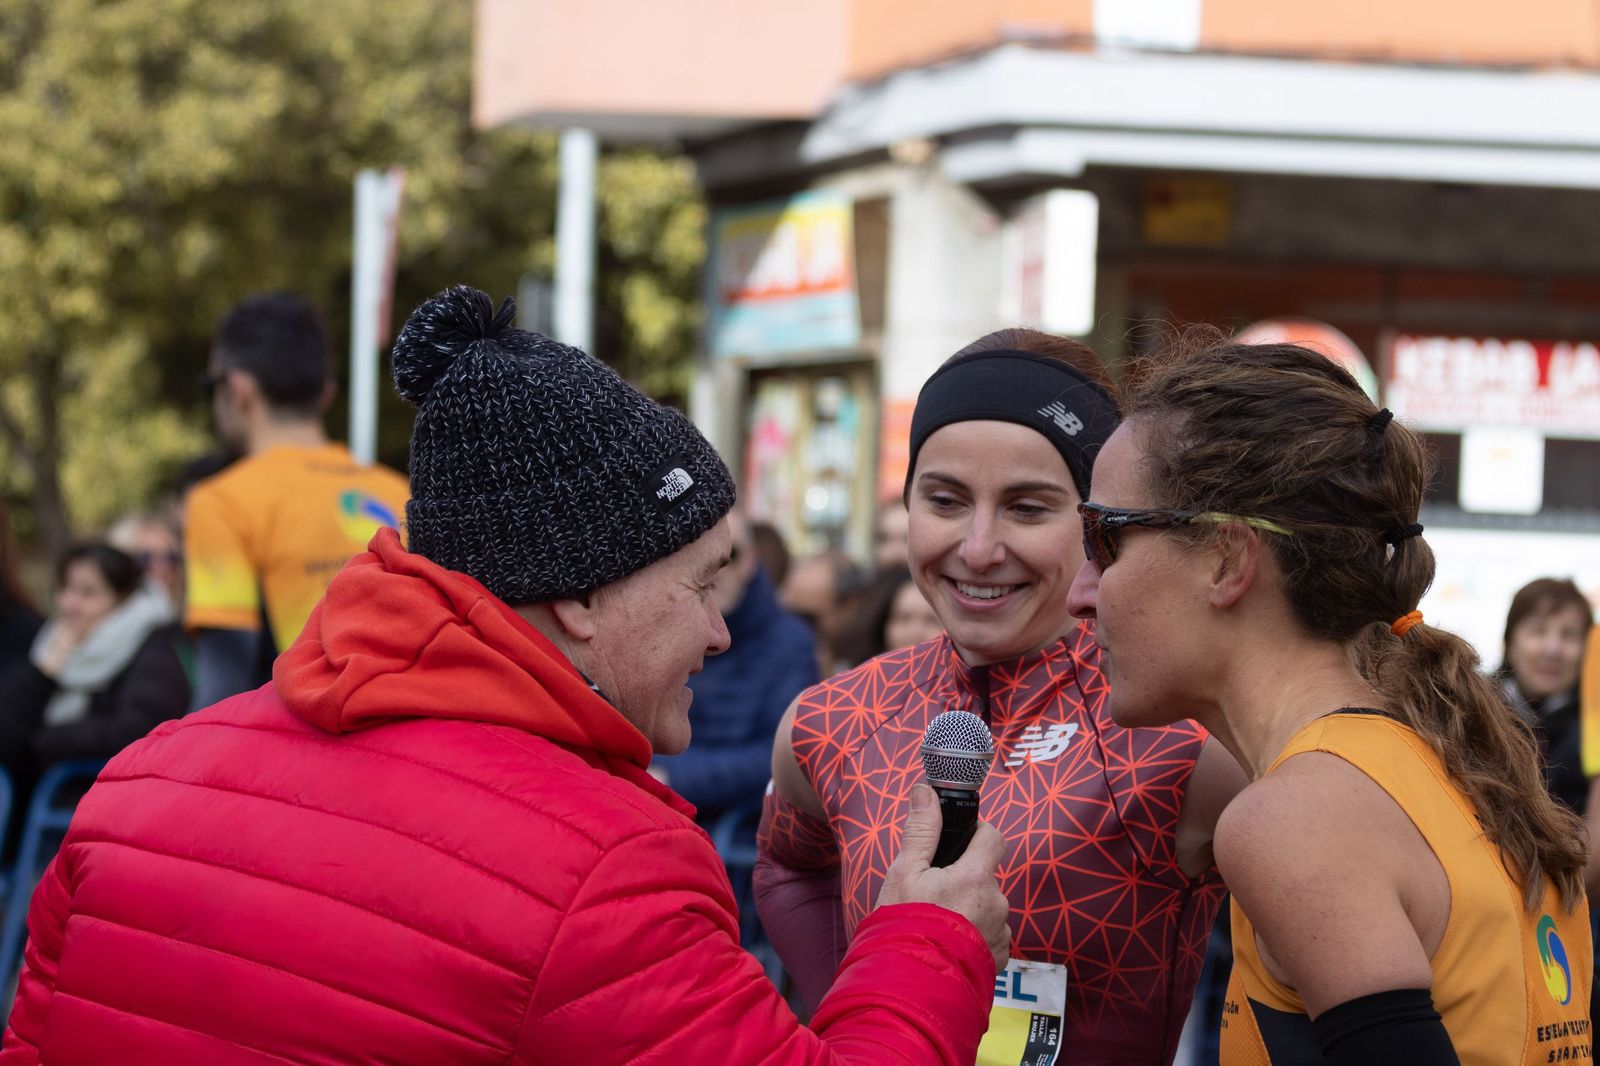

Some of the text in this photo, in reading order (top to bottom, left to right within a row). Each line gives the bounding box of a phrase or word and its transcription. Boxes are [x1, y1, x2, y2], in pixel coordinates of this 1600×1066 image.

[661, 471, 677, 484] THE
[656, 478, 680, 499] NORTH
[667, 483, 685, 502] FACE
[1029, 1021, 1038, 1043] MUJER
[1047, 1027, 1058, 1046] 164
